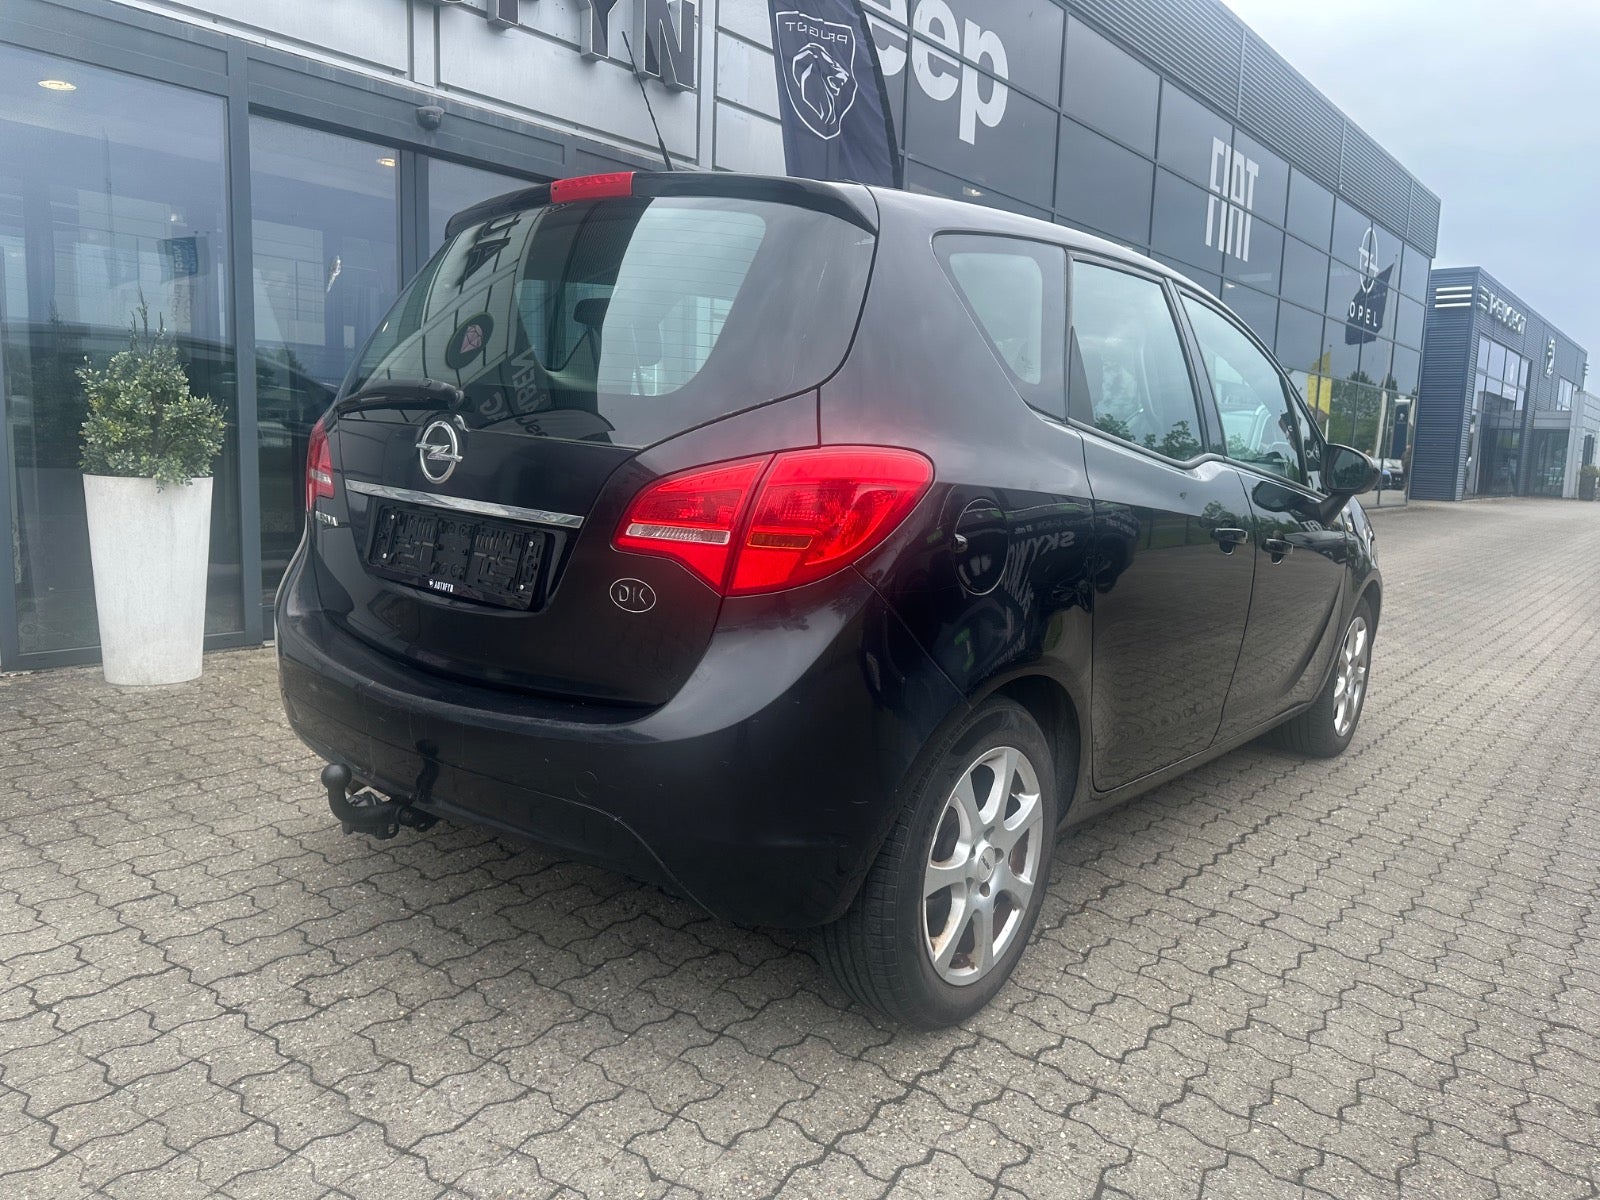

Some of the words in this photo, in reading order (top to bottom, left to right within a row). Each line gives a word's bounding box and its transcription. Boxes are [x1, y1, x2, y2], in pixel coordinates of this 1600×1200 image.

[1204, 136, 1259, 263] FIAT
[1349, 301, 1378, 328] OPEL
[618, 584, 647, 605] DK
